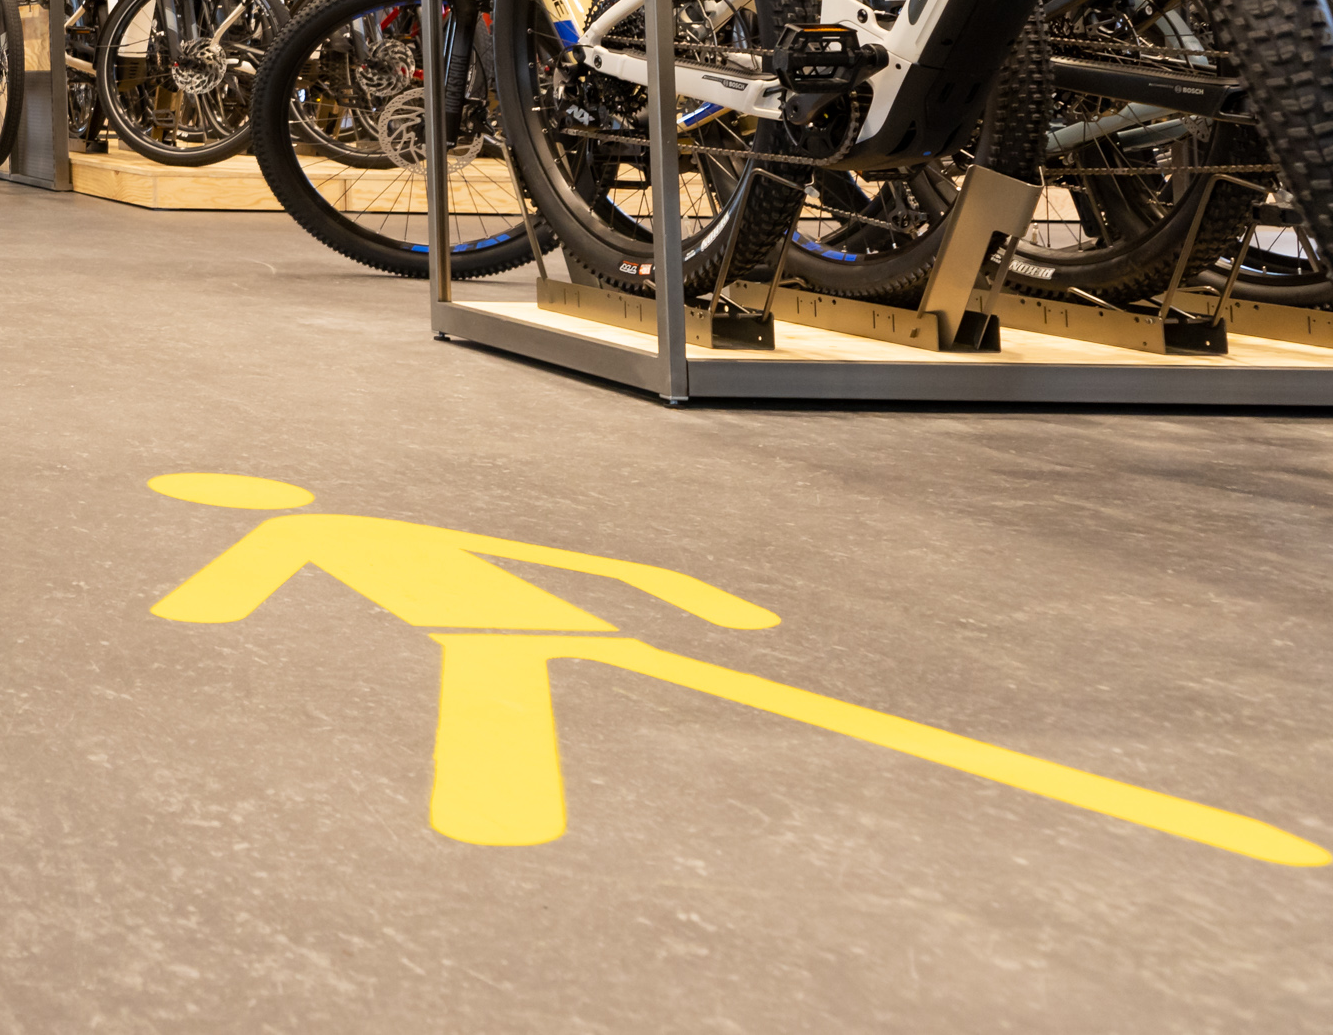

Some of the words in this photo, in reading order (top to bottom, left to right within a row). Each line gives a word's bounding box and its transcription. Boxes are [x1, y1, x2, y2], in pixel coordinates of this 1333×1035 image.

[445, 53, 468, 114] ROCKSHOX
[728, 81, 746, 90] BOSCH
[1182, 86, 1205, 95] BOSCH
[565, 104, 596, 127] NX
